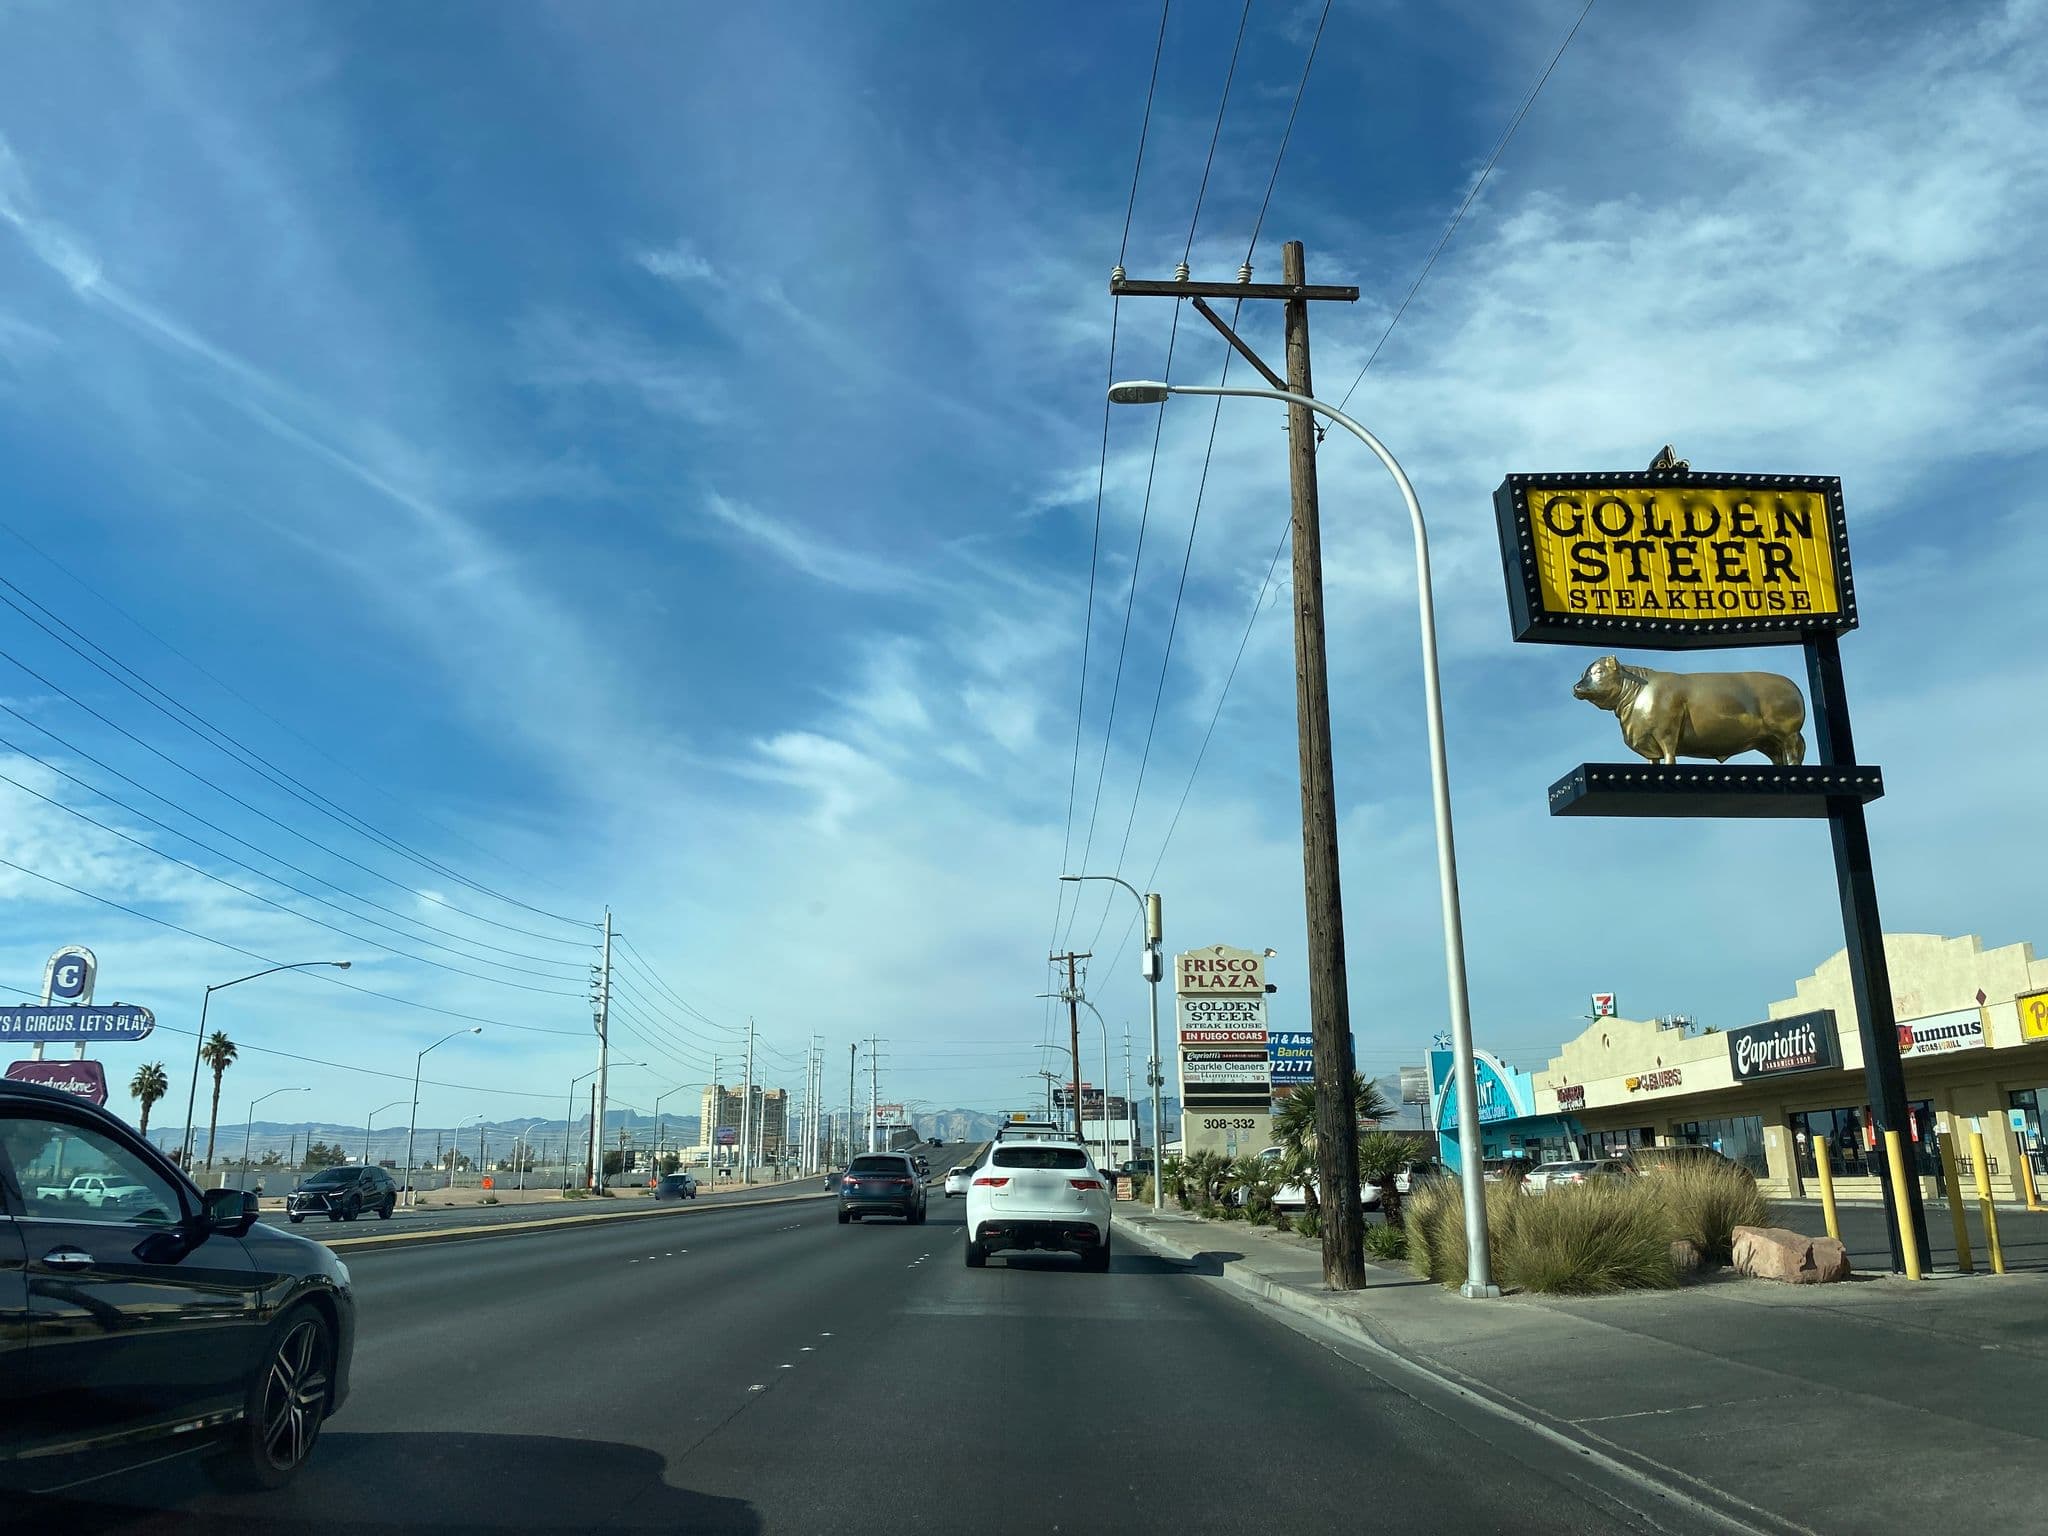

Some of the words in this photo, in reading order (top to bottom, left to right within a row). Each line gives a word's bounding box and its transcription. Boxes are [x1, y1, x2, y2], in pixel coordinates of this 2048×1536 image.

[1543, 495, 1812, 539] GOLDEN
[1570, 540, 1800, 583] STEER
[1569, 589, 1811, 610] STEAKHOUSE
[1184, 959, 1258, 972] FRISCO
[1184, 975, 1259, 988] PLAZA
[1185, 1002, 1260, 1012] GOLDEN
[1191, 1012, 1256, 1021] STEER
[13, 1015, 21, 1031] A
[25, 1015, 75, 1032] CIRCUS.
[80, 1015, 112, 1031] LET'S
[1281, 1034, 1288, 1044] &
[1736, 1023, 1816, 1075] Capriotti's
[1188, 1063, 1222, 1071] Sparkle
[1203, 1118, 1255, 1129] 308-332
